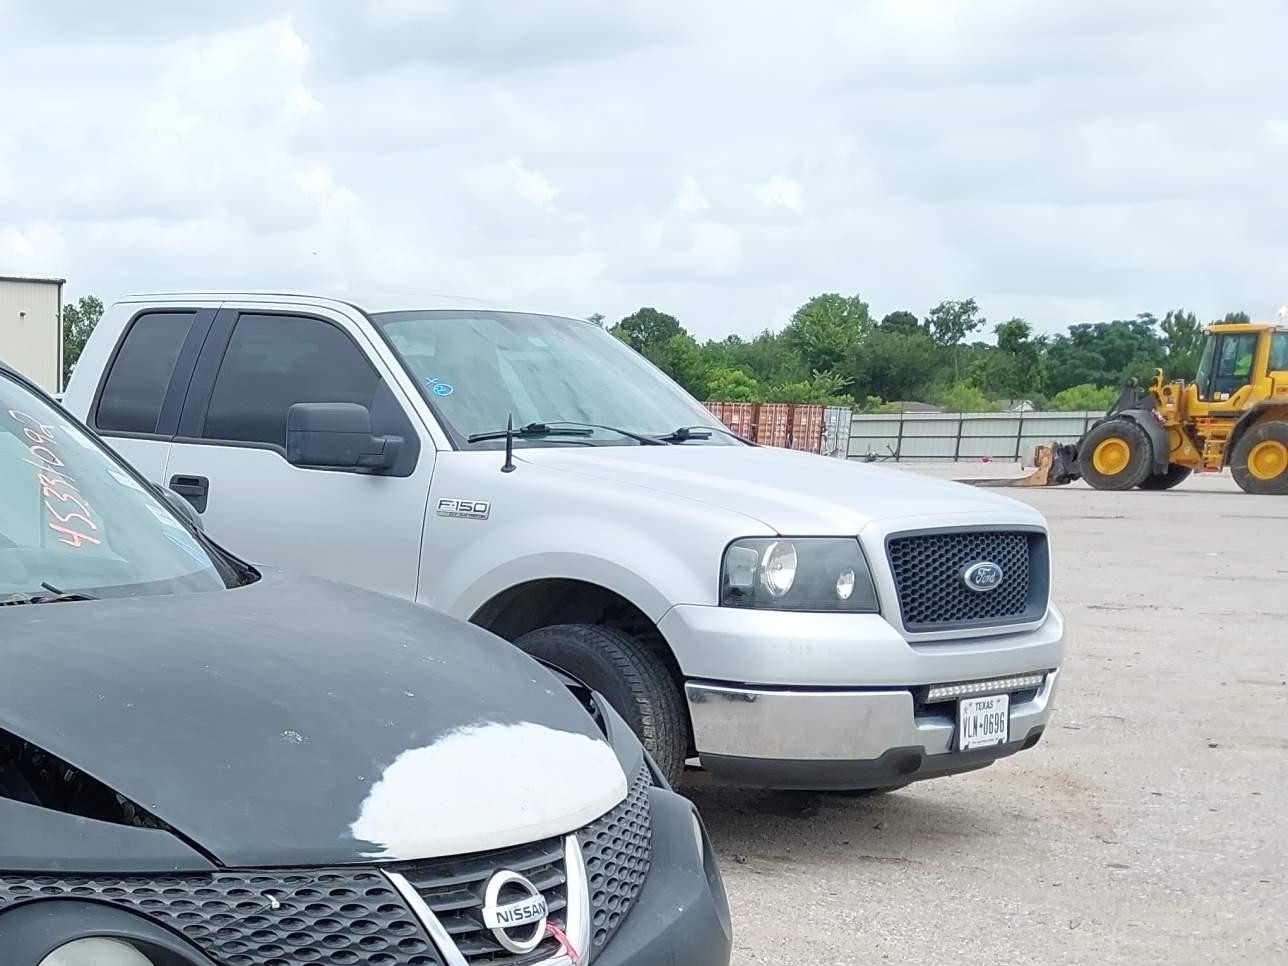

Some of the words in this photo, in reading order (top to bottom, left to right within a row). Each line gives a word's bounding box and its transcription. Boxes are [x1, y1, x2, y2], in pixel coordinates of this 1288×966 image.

[975, 567, 996, 584] Ford
[975, 700, 994, 711] TEXAS
[496, 901, 546, 923] NISSAN
